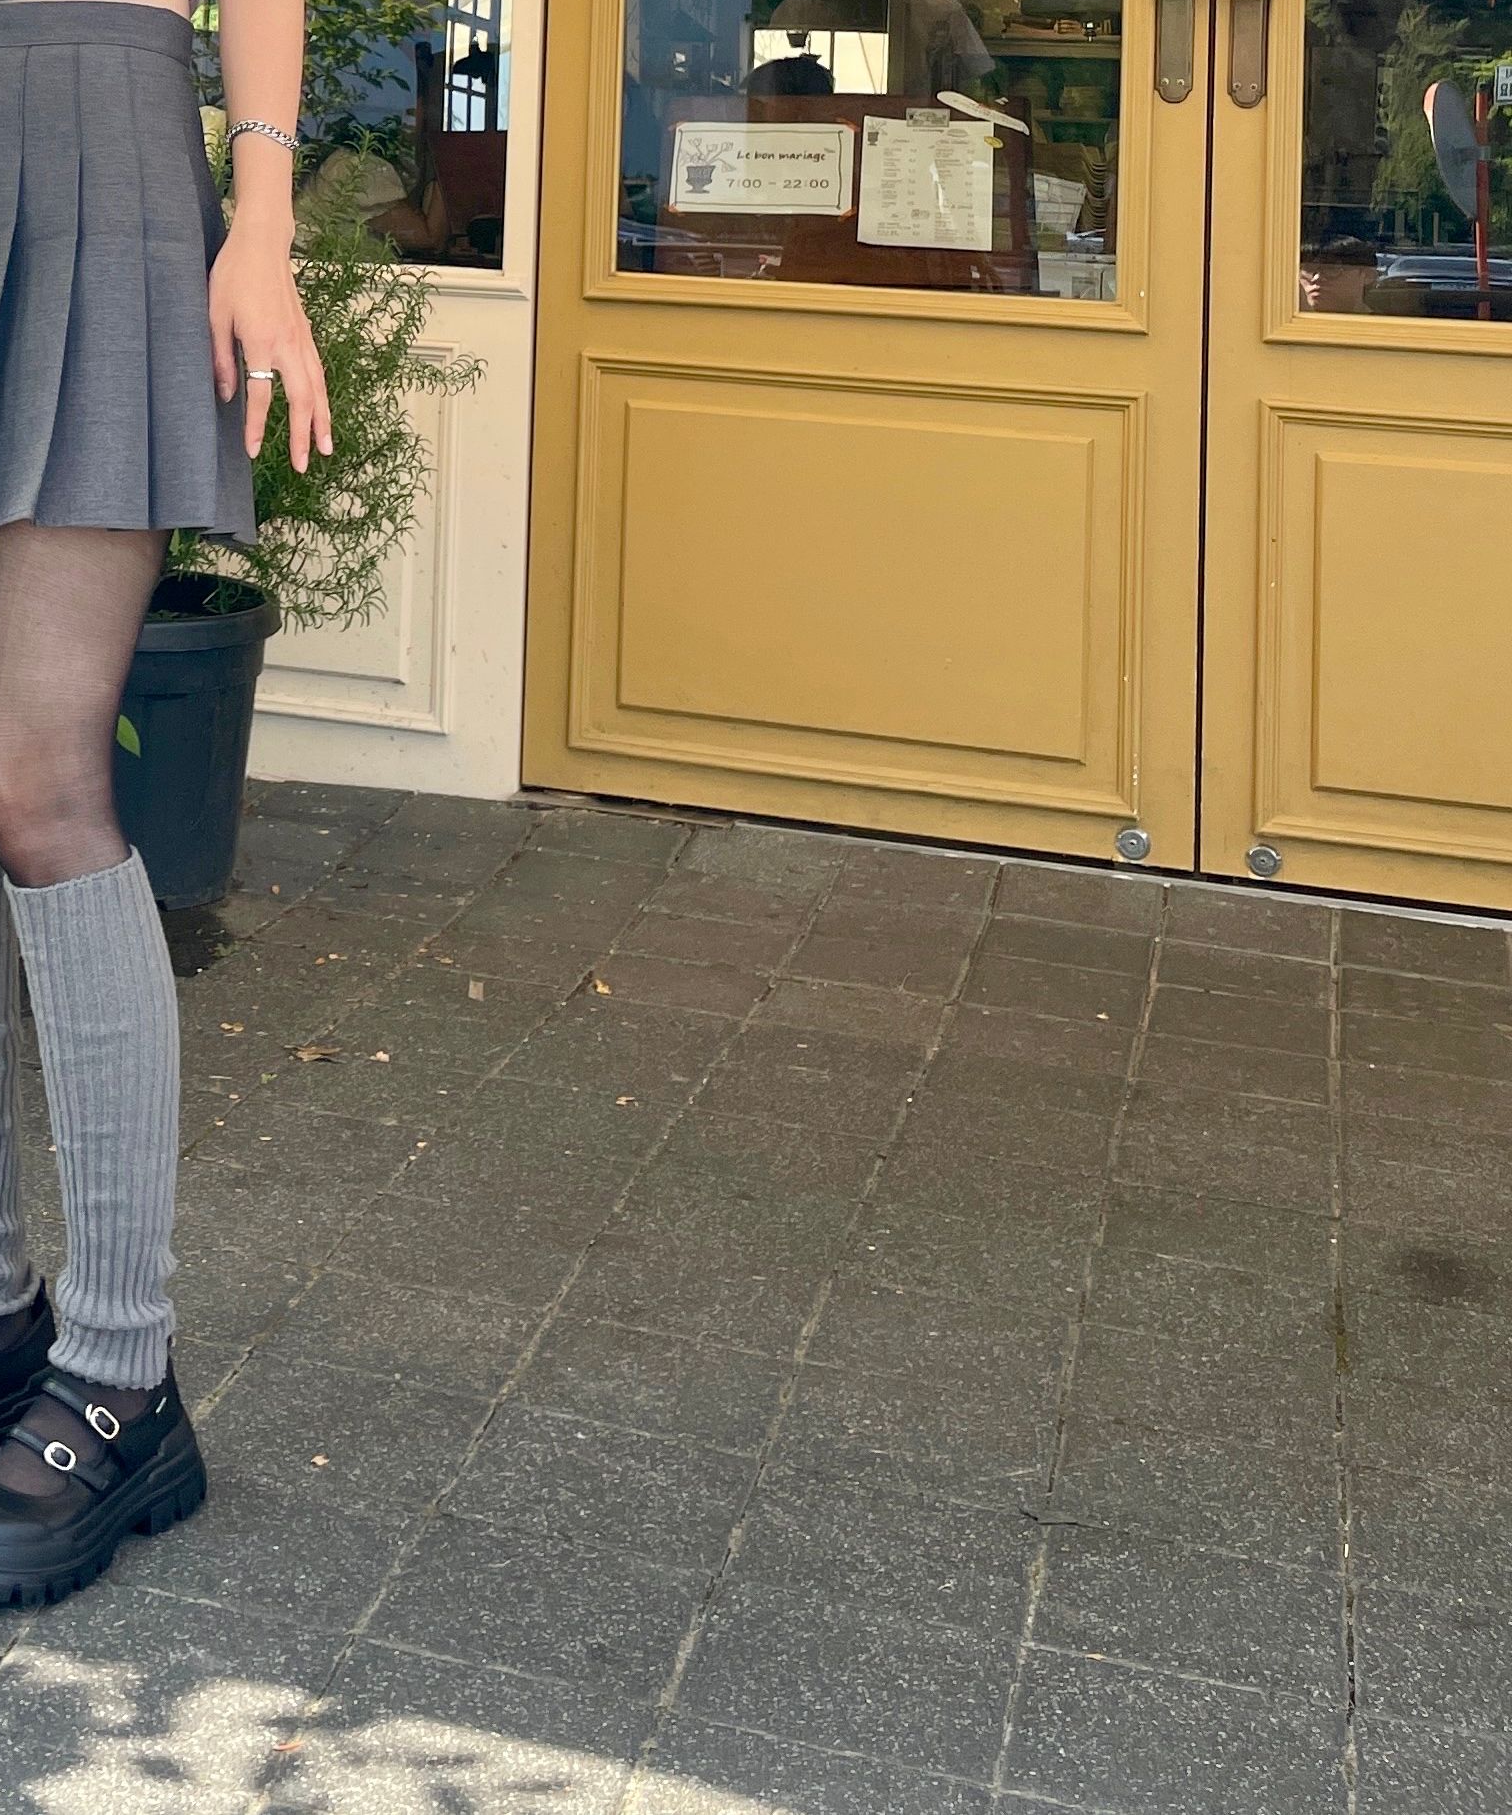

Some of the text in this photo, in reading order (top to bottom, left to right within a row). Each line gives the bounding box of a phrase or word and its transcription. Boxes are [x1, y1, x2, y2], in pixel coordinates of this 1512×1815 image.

[737, 148, 826, 163] Le bon mariage
[726, 178, 762, 188] 7:00
[783, 178, 829, 189] 22:00
